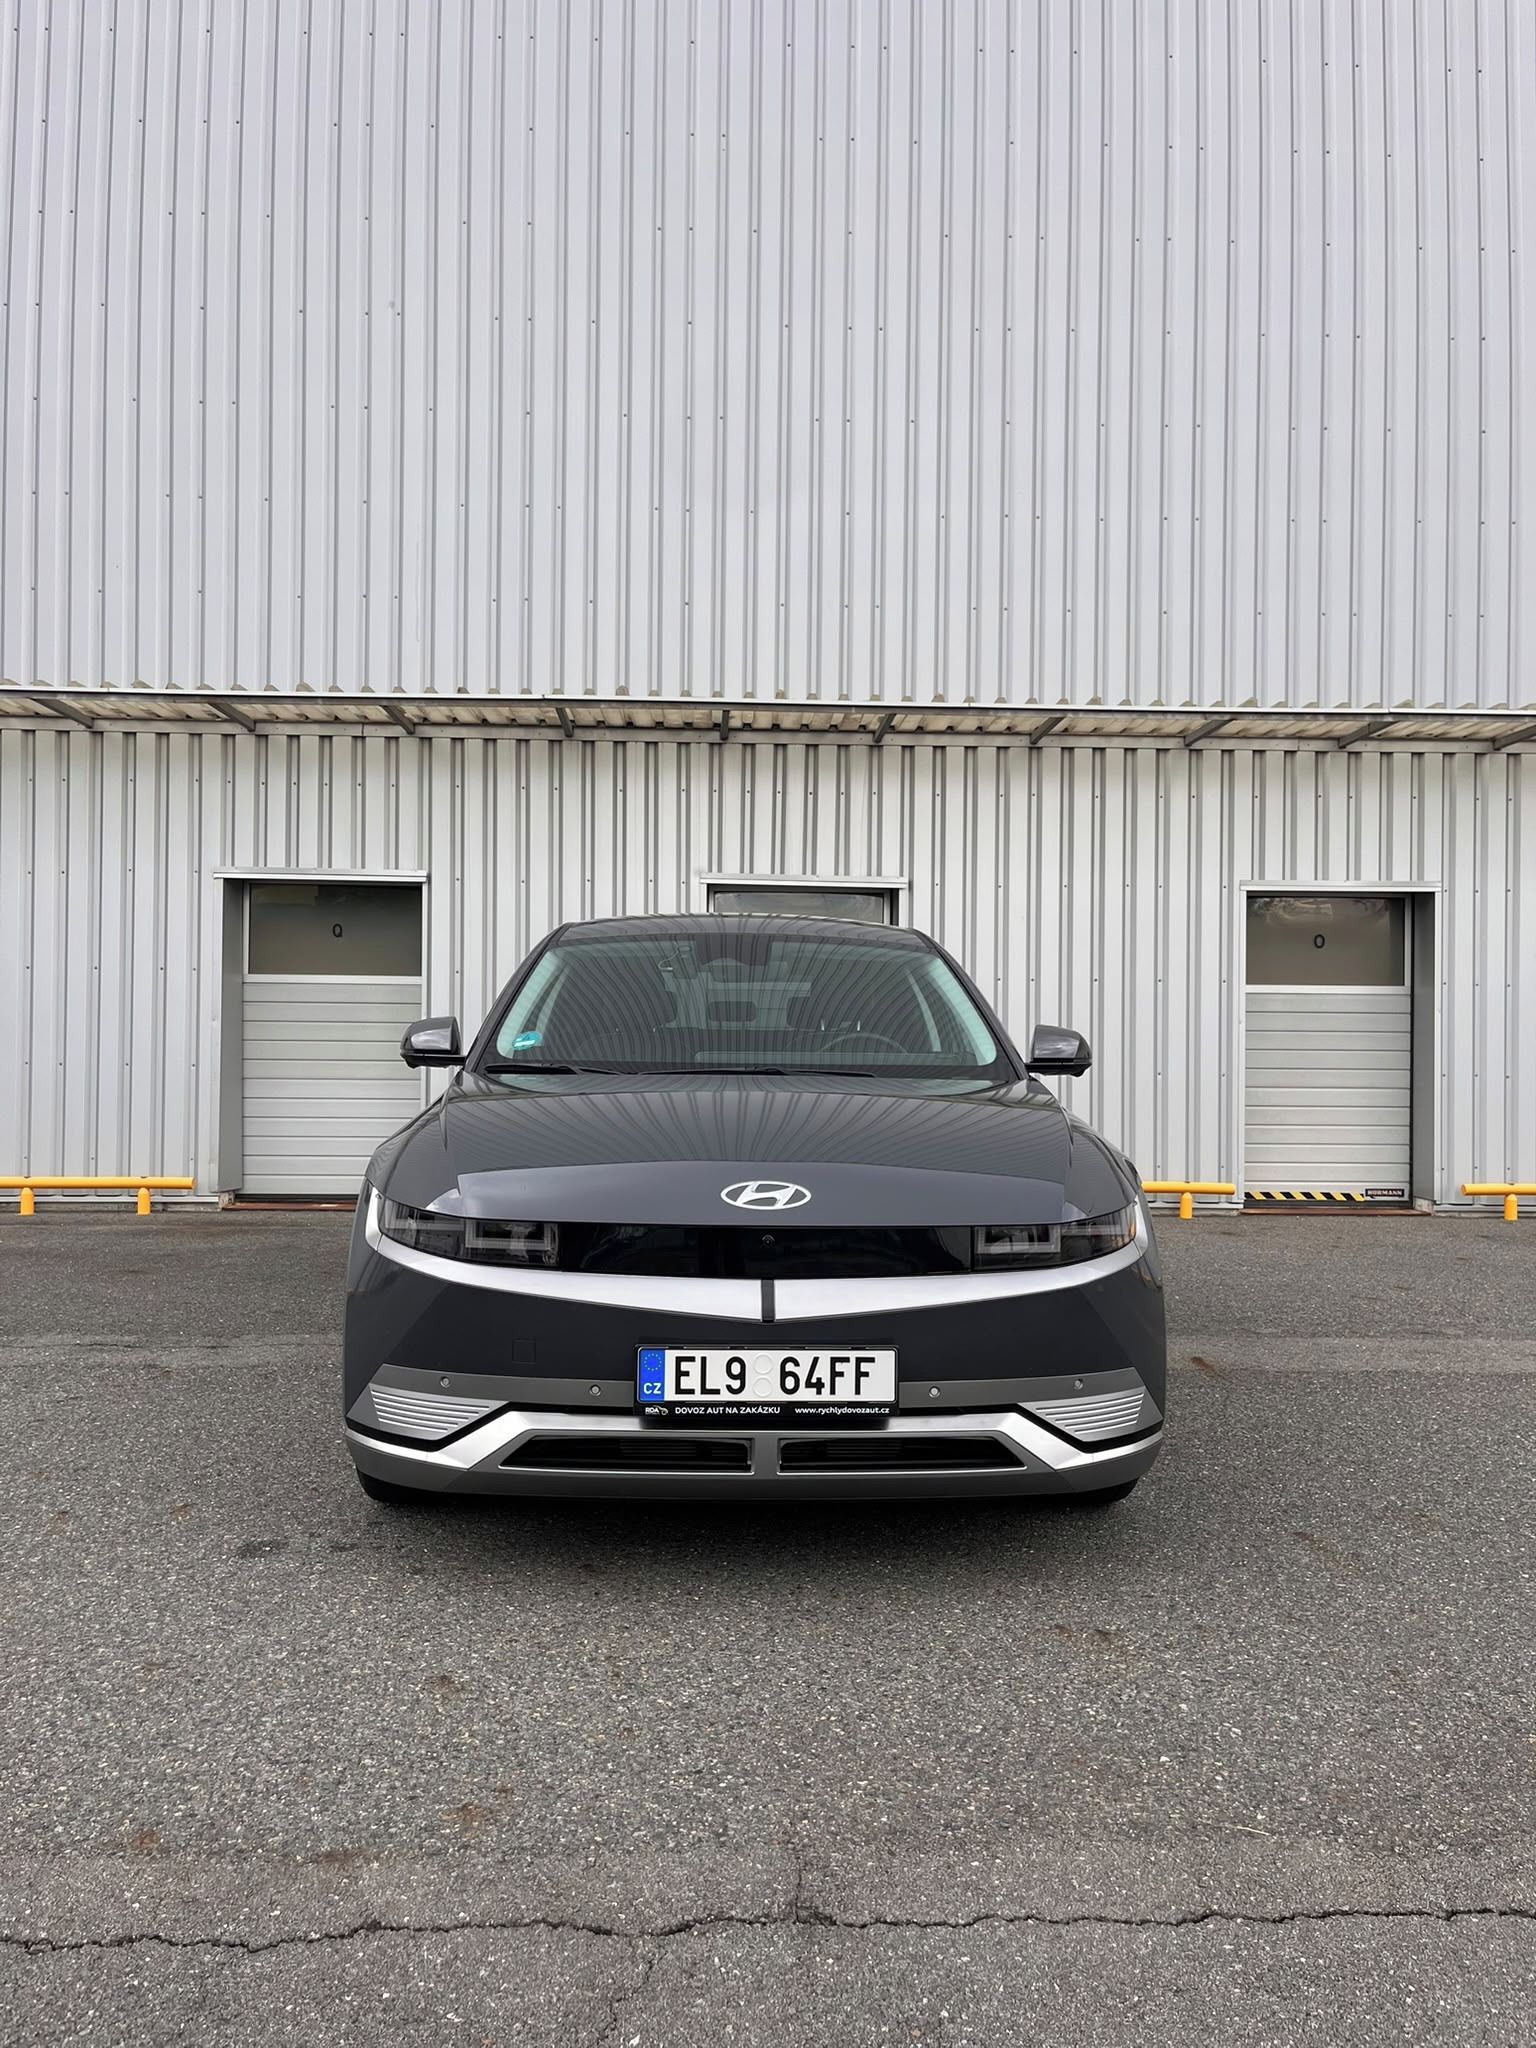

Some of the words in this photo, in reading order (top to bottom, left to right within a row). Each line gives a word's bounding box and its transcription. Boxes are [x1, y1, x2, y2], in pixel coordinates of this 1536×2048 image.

[674, 1356, 746, 1395] EL9
[779, 1356, 876, 1395] 64FF
[643, 1382, 662, 1395] CZ
[675, 1406, 705, 1414] DOVOZ
[706, 1406, 724, 1414] AUT
[725, 1406, 739, 1414] NA
[740, 1405, 780, 1414] ZAKÁZKU
[795, 1406, 890, 1415] www.rychlydovozaut.cz
